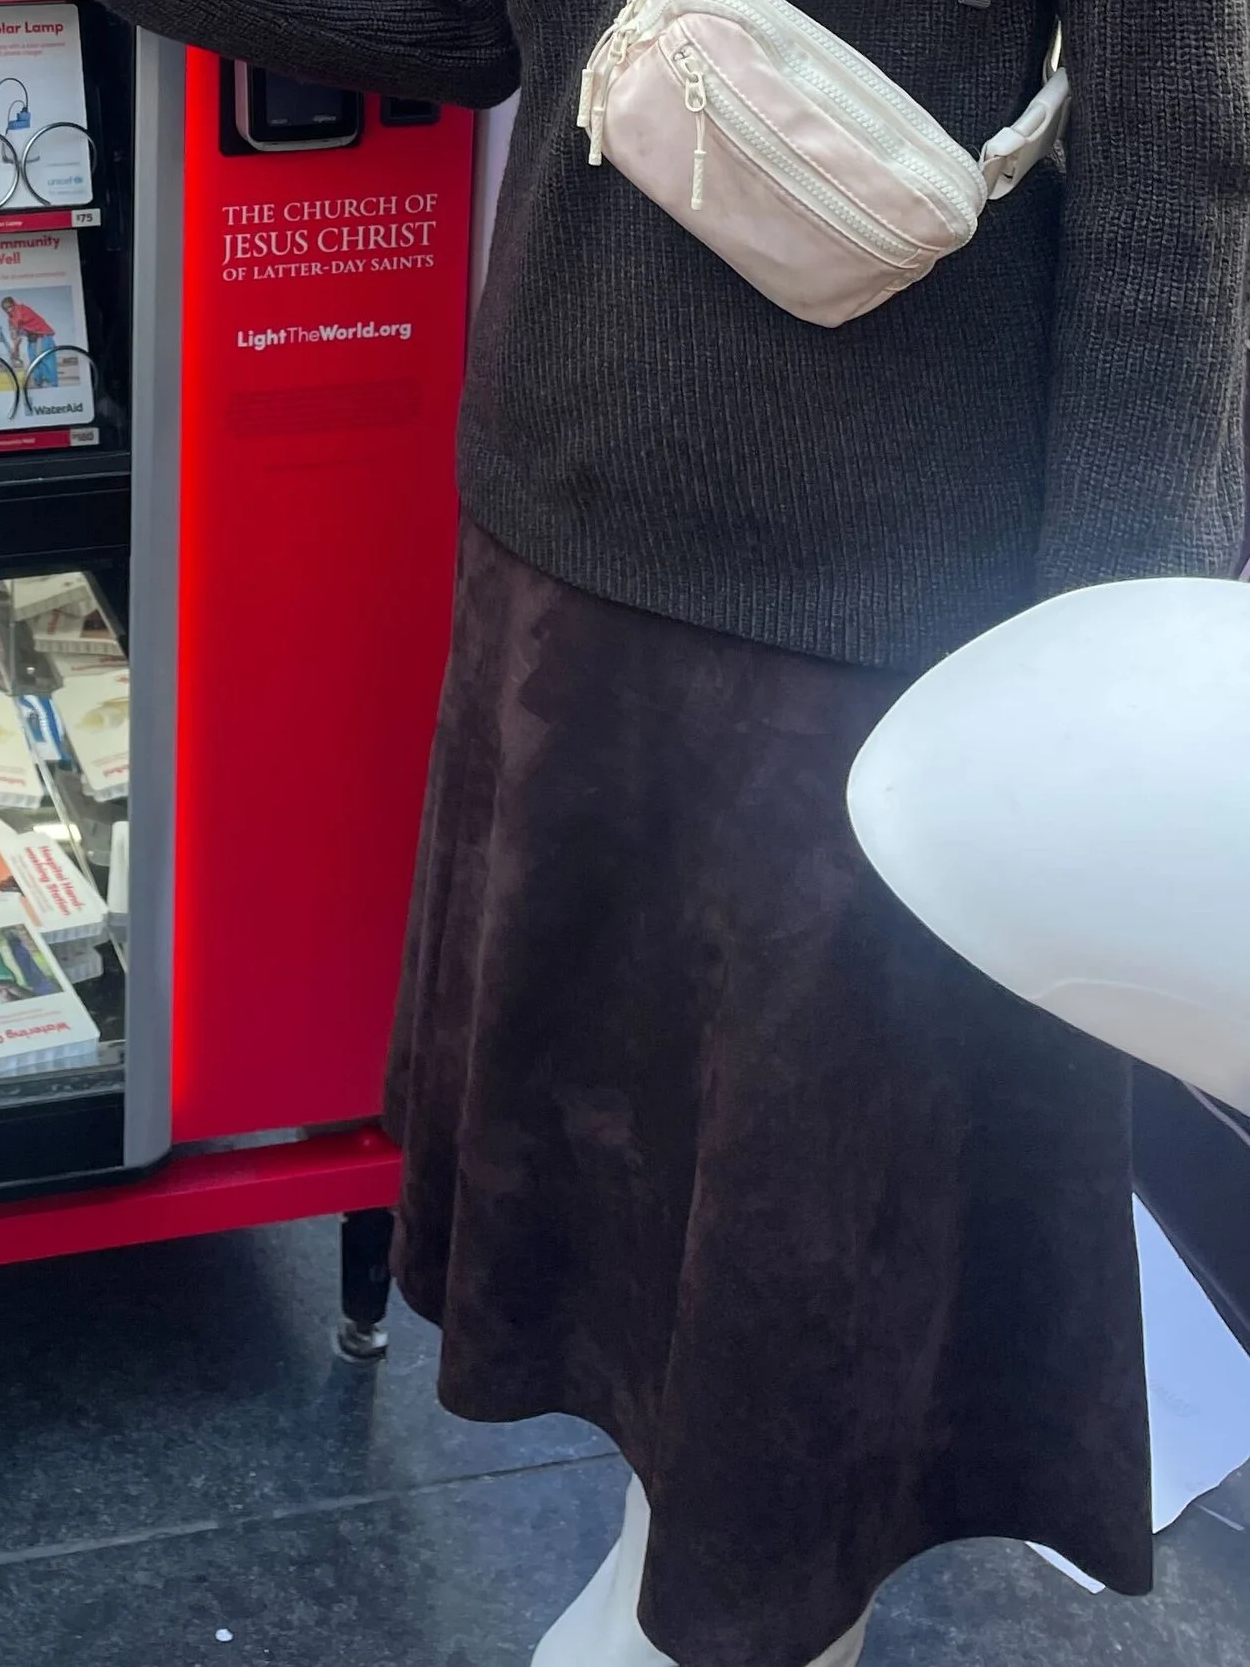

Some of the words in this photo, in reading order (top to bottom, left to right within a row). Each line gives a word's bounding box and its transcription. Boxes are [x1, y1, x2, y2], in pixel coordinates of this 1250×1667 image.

[24, 22, 64, 37] Lamp
[222, 203, 275, 226] THE
[283, 198, 398, 222] CHURCH
[404, 194, 438, 215] OF
[222, 230, 309, 265] JESUS
[317, 221, 437, 254] CHRIST
[222, 267, 247, 282] OF
[252, 258, 367, 281] LATTER-DAY
[371, 254, 435, 272] SAINTS
[237, 322, 412, 350] LightTheWorld.org
